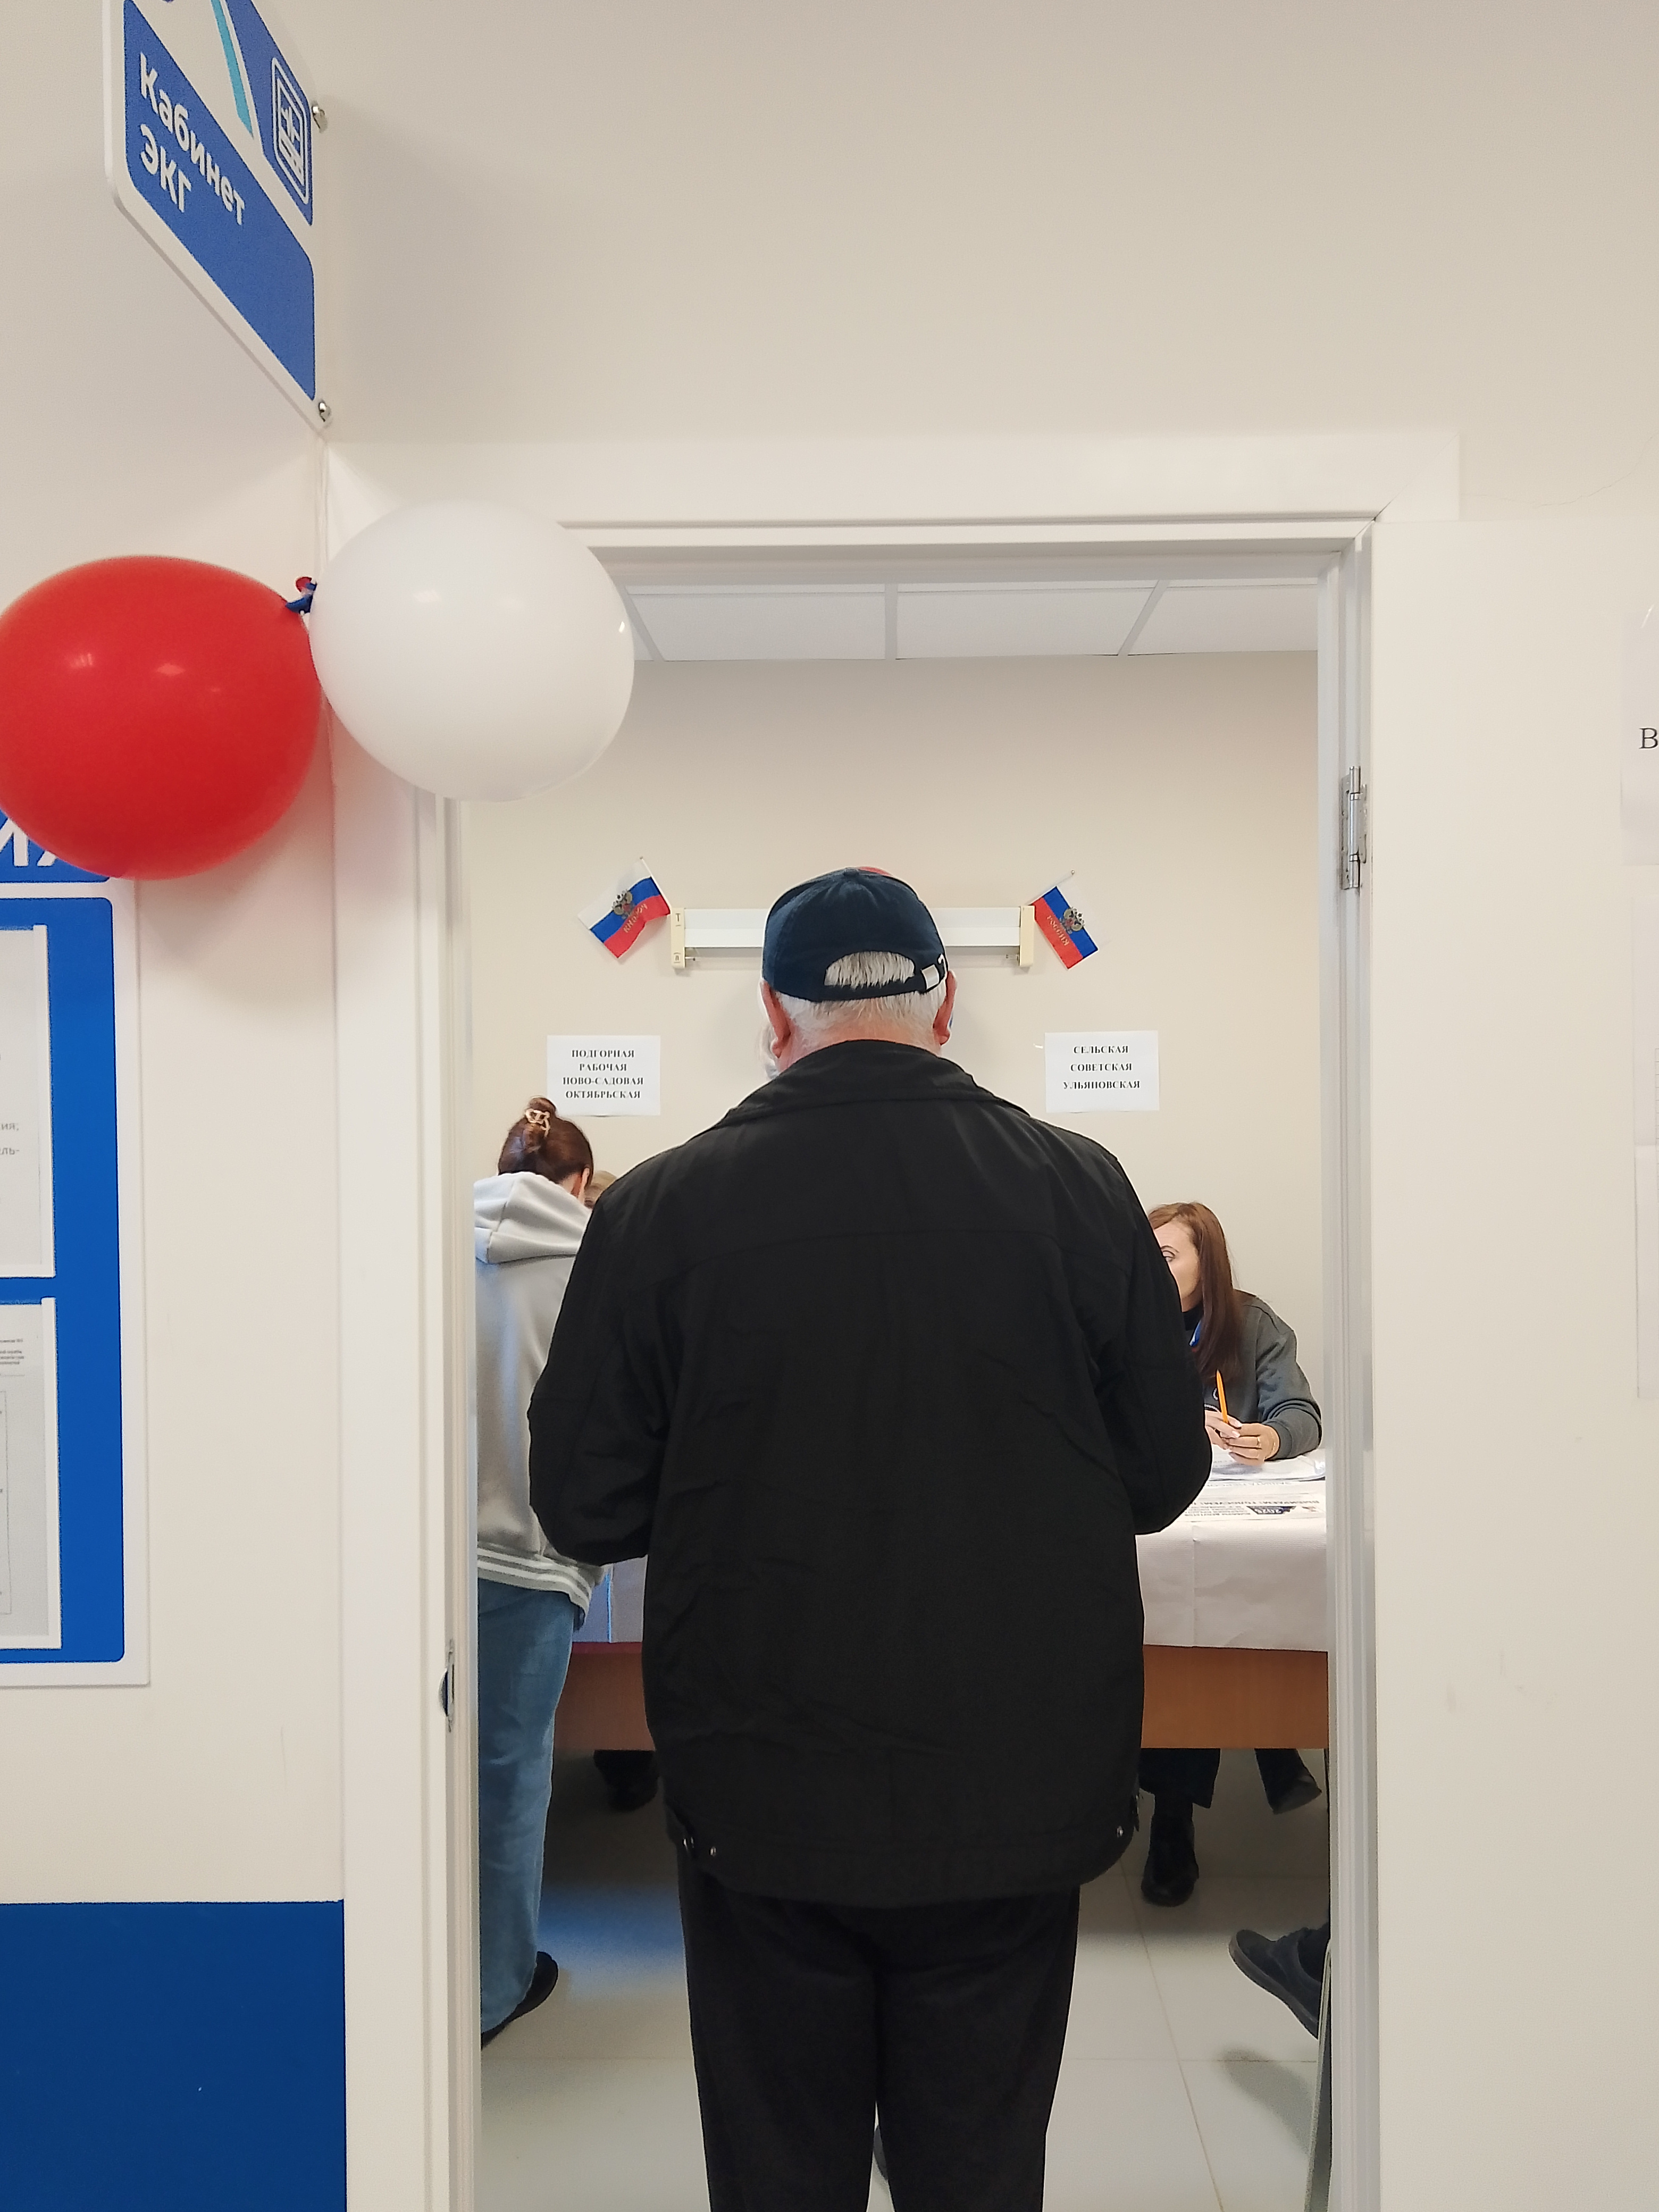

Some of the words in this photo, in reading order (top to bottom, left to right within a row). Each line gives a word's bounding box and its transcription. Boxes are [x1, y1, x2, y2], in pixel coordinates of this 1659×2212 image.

[140, 52, 245, 225] Кабинет
[140, 123, 191, 213] ЭКГ
[572, 1050, 634, 1058] ПОДГОРНАЯ
[1074, 1045, 1128, 1054] СЕЛЬСКАЯ
[1070, 1063, 1132, 1071] СОВЕТСКАЯ
[1063, 1080, 1140, 1090] УЛЬЯНОВСКАЯ
